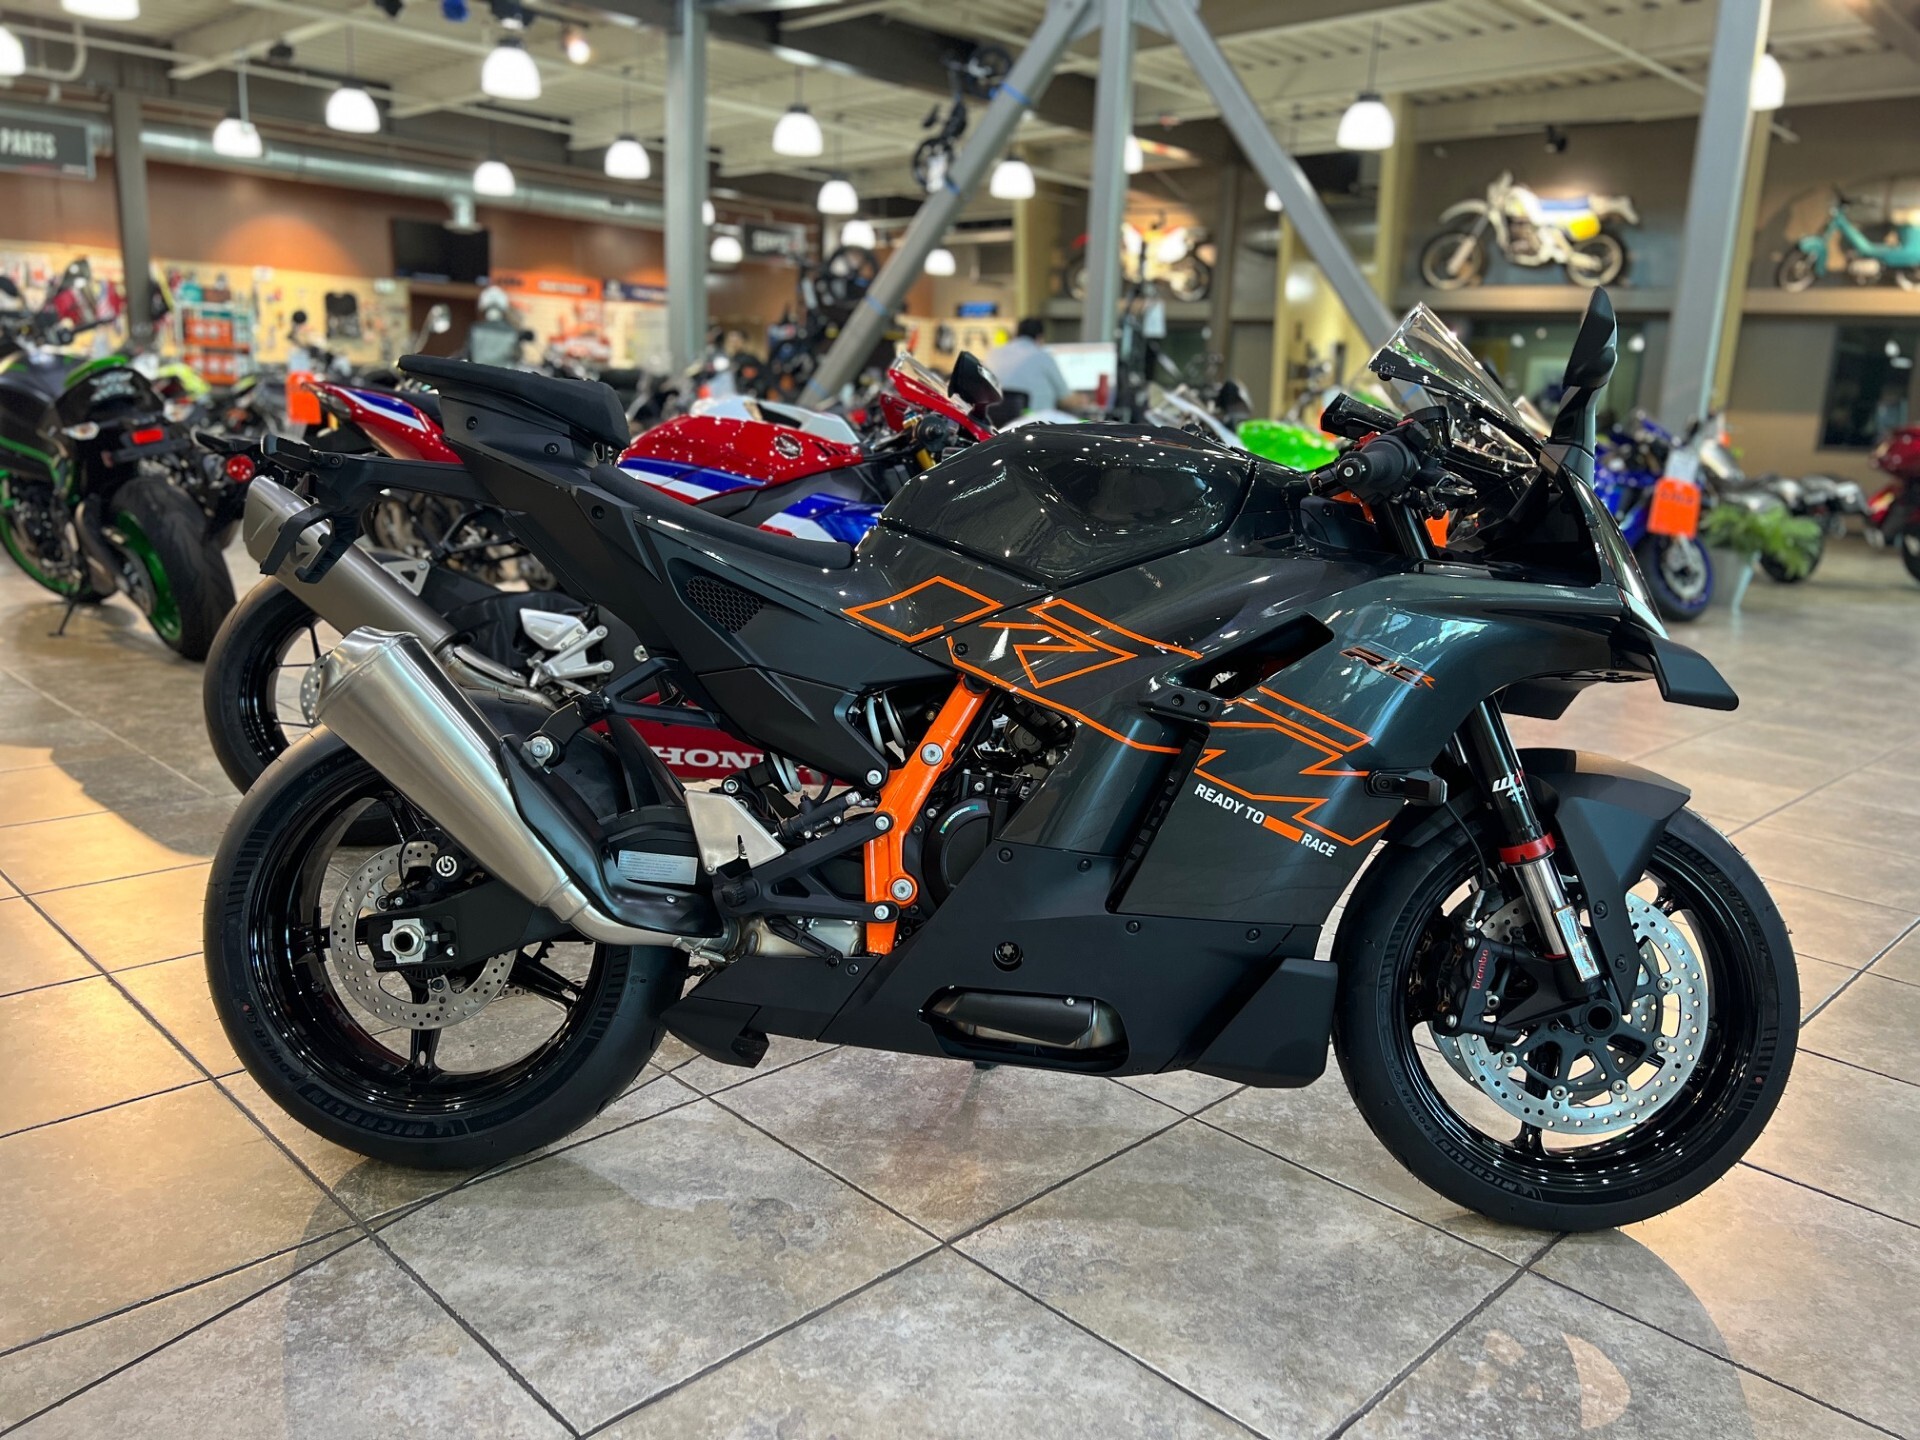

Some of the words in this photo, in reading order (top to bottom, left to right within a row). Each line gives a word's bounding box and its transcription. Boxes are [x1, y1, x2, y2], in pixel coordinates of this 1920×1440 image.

[0, 127, 57, 160] PARTS
[650, 745, 766, 770] HON
[1194, 783, 1245, 814] READY
[1245, 806, 1265, 825] TO
[1301, 833, 1337, 858] RACE
[1472, 949, 1489, 990] brembo
[252, 1027, 301, 1083] POWER
[306, 1086, 427, 1135] MICHELIN
[1400, 1088, 1432, 1132] POWER
[1437, 1139, 1517, 1192] MICHELIN
